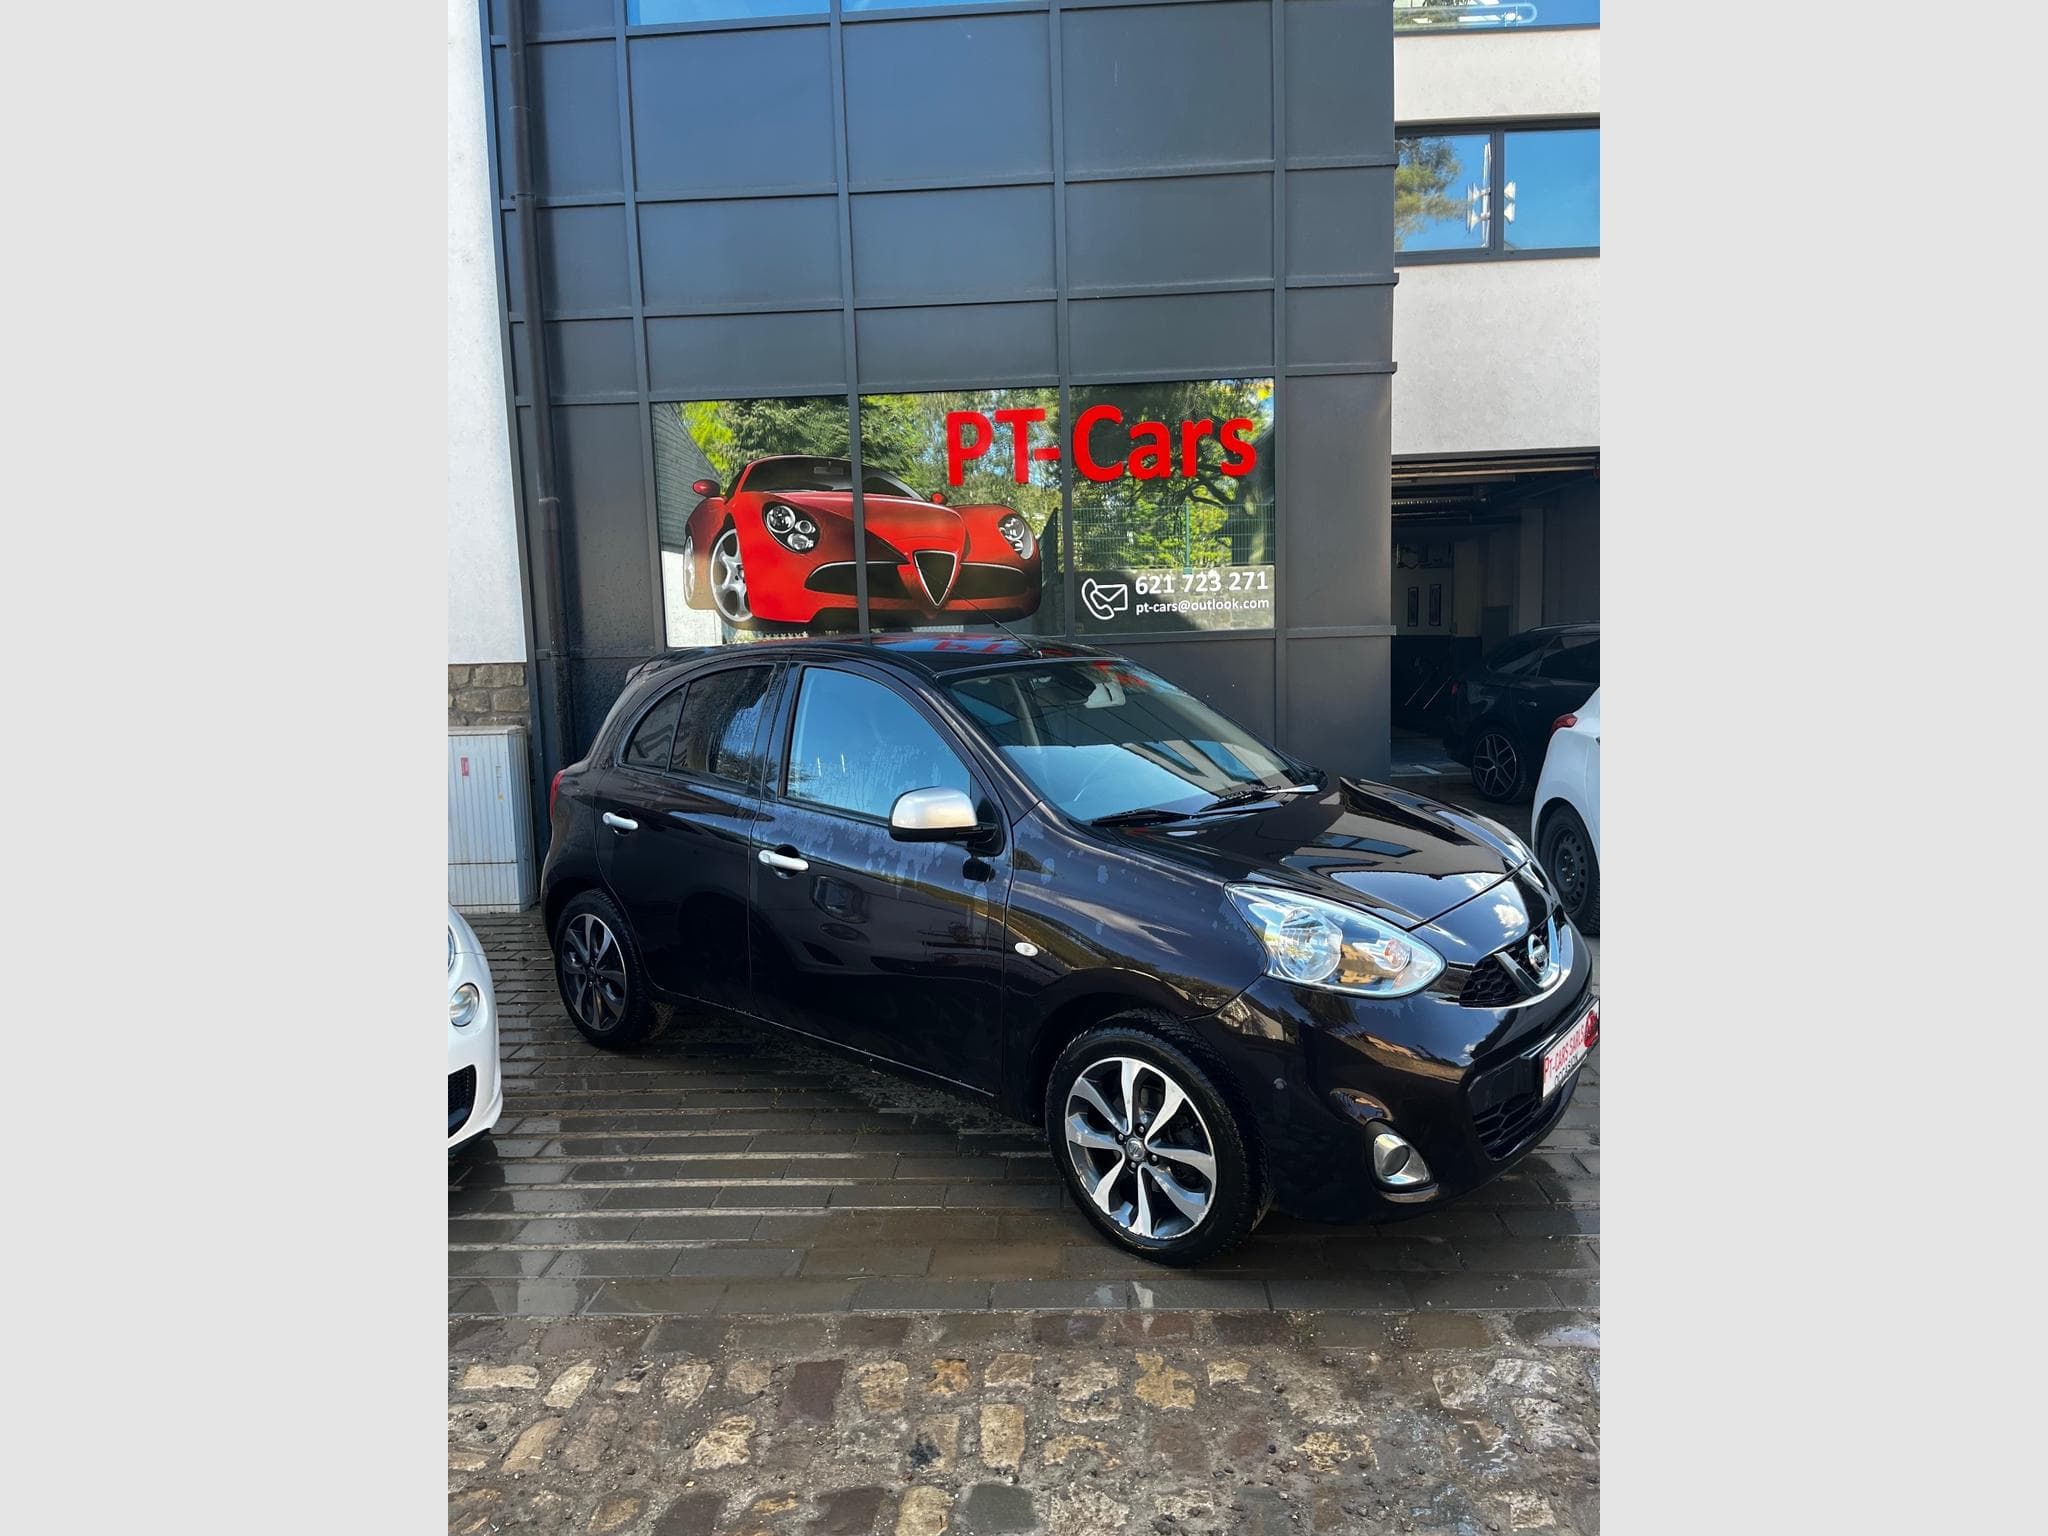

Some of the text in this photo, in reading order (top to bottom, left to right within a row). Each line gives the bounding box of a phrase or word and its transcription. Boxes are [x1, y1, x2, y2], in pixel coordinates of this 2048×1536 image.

[946, 404, 1258, 487] PT-Cars
[1135, 571, 1268, 595] 621 723 271
[1136, 598, 1269, 616] pt-cars@outlook.com
